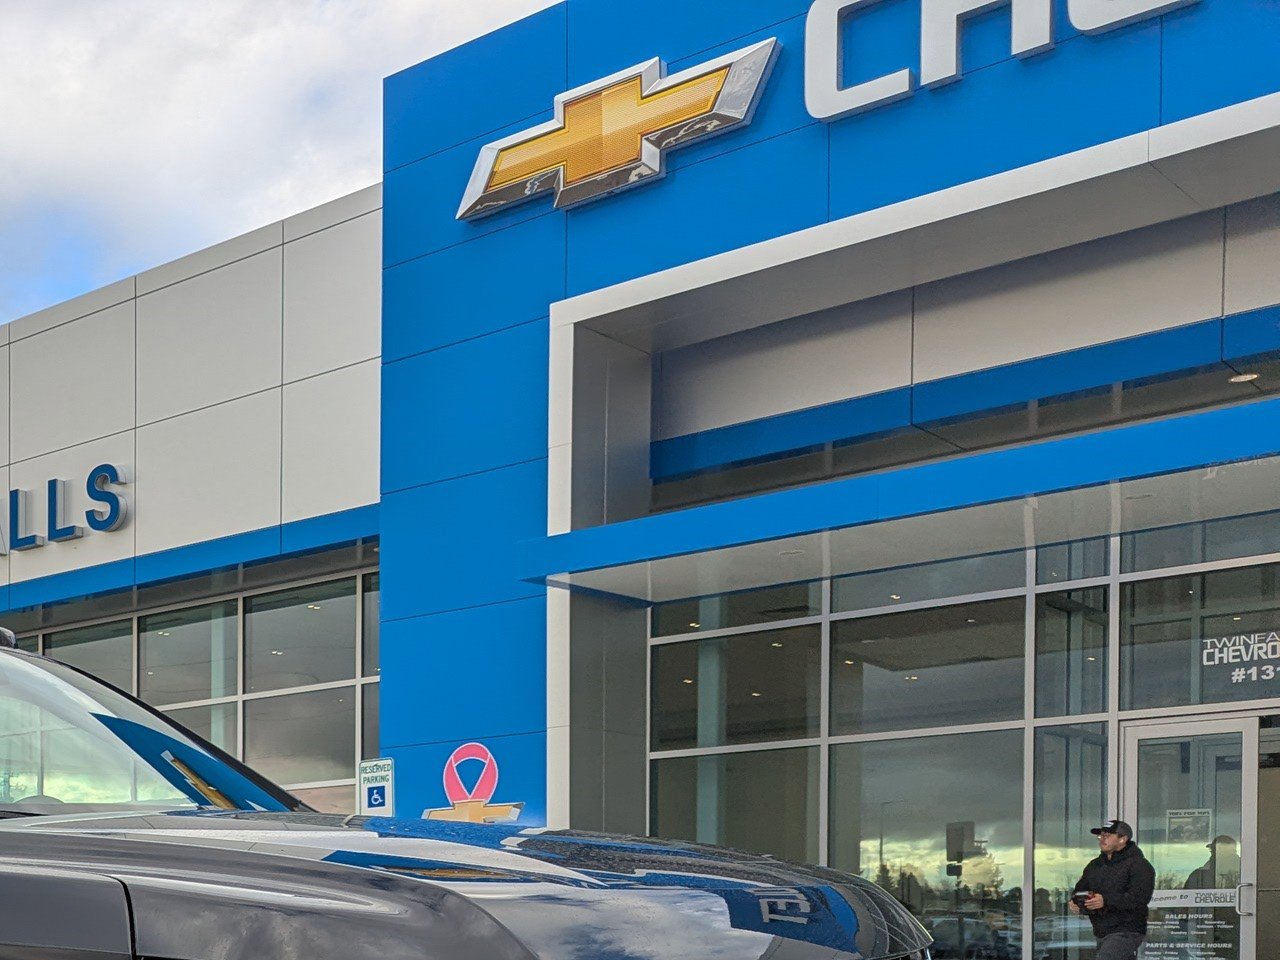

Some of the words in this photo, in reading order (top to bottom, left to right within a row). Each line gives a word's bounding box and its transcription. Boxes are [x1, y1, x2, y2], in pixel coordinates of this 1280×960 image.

[1203, 632, 1280, 649] TWINFA
[1203, 642, 1280, 666] CHEVRO
[360, 763, 391, 774] RESERVED
[363, 774, 390, 784] PARKING
[1194, 896, 1235, 904] CHEVROLE
